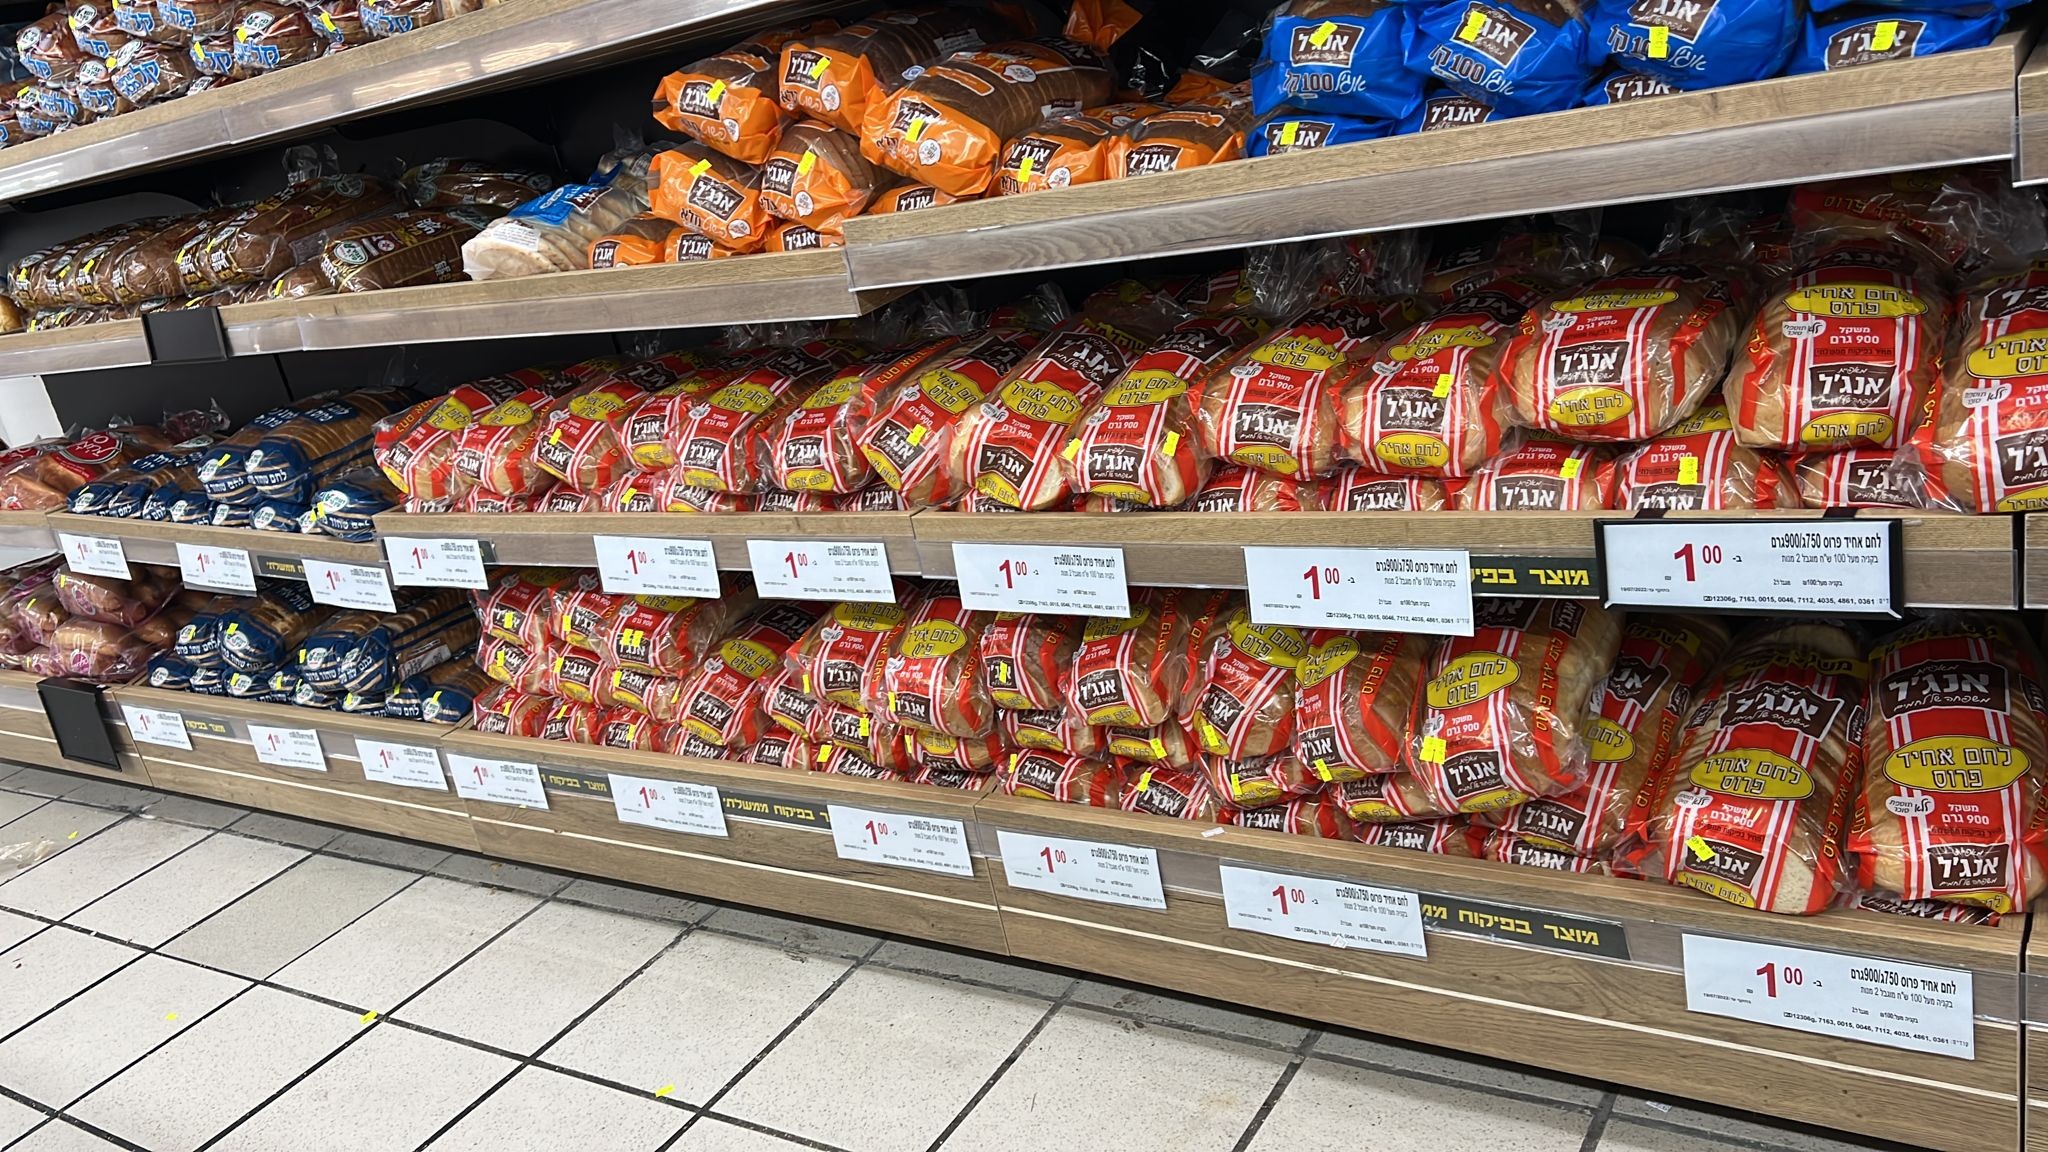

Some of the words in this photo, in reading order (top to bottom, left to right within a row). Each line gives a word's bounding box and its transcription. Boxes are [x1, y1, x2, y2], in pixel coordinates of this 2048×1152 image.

[1449, 54, 1486, 84] 100
[1302, 72, 1335, 91] 100
[1430, 104, 1482, 123] אנג'ל
[1830, 301, 1880, 316] פרוס
[1838, 325, 1871, 334] משקל
[1830, 336, 1854, 345] גרם
[1855, 335, 1880, 345] 900
[1983, 336, 2048, 360] אחיד
[1271, 351, 1309, 366] פרוס
[1560, 350, 1618, 374] אנג'ל
[1818, 373, 1885, 396] אנג'ל
[1018, 399, 1049, 418] פרוס
[1050, 393, 1078, 412] לחם
[1387, 398, 1438, 419] אנג'ל
[1555, 398, 1590, 414] אחיד
[1594, 395, 1624, 409] לחם
[2015, 394, 2042, 408] גרם
[1123, 420, 1139, 430] 900
[1576, 410, 1606, 425] פרוס
[1811, 423, 1850, 438] אחיד
[1856, 418, 1887, 436] לחם
[1381, 441, 1411, 456] אחיד
[1418, 442, 1442, 457] לחם
[1660, 444, 1687, 452] משקל
[986, 451, 1025, 476] אנג'ל
[1093, 454, 1135, 472] אנג'ל
[1502, 488, 1555, 507] אנג'ל
[1771, 532, 1822, 549] 750ג/900גרם
[1823, 536, 1843, 549] פרוס
[1844, 536, 1864, 549] אחיד
[1865, 532, 1882, 549] לחם
[1445, 559, 1458, 574] לחם
[1673, 543, 1697, 582] 1
[1702, 544, 1723, 565] 00
[1781, 554, 1795, 563] מנות
[1795, 553, 1801, 563] 2
[1801, 553, 1819, 564] מוגבל
[1833, 553, 1847, 564] 100
[1847, 553, 1861, 564] מעל
[1861, 554, 1879, 565] בקניה
[998, 559, 1014, 590] 1
[1015, 560, 1028, 577] 00
[1414, 561, 1429, 573] פרוס
[1429, 561, 1445, 574] אחיד
[1302, 565, 1322, 600] 1
[1325, 567, 1341, 585] 00
[1528, 568, 1591, 587] מוצר
[826, 667, 858, 684] אנג'ל
[1469, 657, 1508, 679] לחם
[1080, 679, 1118, 701] אנג'ל
[1446, 681, 1481, 702] פרוס
[1888, 673, 1990, 702] אנג'ל
[1735, 691, 1819, 721] אנג'ל
[1892, 695, 1930, 713] לחמים
[1930, 692, 1943, 703] של
[1943, 695, 1992, 705] משפחה
[693, 696, 727, 726] אנג'ל
[1451, 714, 1473, 724] משקל
[1445, 726, 1462, 737] גרם
[1461, 722, 1481, 733] 900
[1586, 724, 1627, 748] לחם
[1704, 756, 1751, 774] אחיד
[1896, 748, 1956, 769] אחיד
[1963, 747, 2014, 767] לחם
[1449, 759, 1497, 787] אנג'ל
[1757, 760, 1802, 785] לחם
[1931, 768, 1984, 789] פרוס
[583, 778, 607, 793] מוצר
[1720, 774, 1766, 796] פרוס
[722, 797, 770, 814] ממשלתי
[1888, 799, 1914, 809] תוספת
[1914, 798, 1932, 813] ללא
[1947, 803, 1980, 813] משקל
[773, 804, 816, 823] בפיקוח
[1524, 806, 1575, 836] אנג'ל
[1941, 814, 1965, 824] גרם
[1967, 814, 1991, 826] 900
[1039, 846, 1055, 874] 1
[1937, 855, 1999, 879] אנג'ל
[1271, 885, 1289, 916] 1
[1290, 888, 1306, 904] 00
[1718, 886, 1748, 905] לחם
[1457, 908, 1533, 936] בפיקוח
[1543, 925, 1601, 947] מוצר
[1755, 962, 1778, 999] 1
[1783, 966, 1804, 987] 00
[1900, 976, 1919, 990] פרוס
[1920, 979, 1939, 993] אחיד
[1941, 981, 1957, 996] לחם
[1874, 987, 1880, 996] 2
[1910, 993, 1923, 1004] 100
[1923, 995, 1936, 1006] מעל
